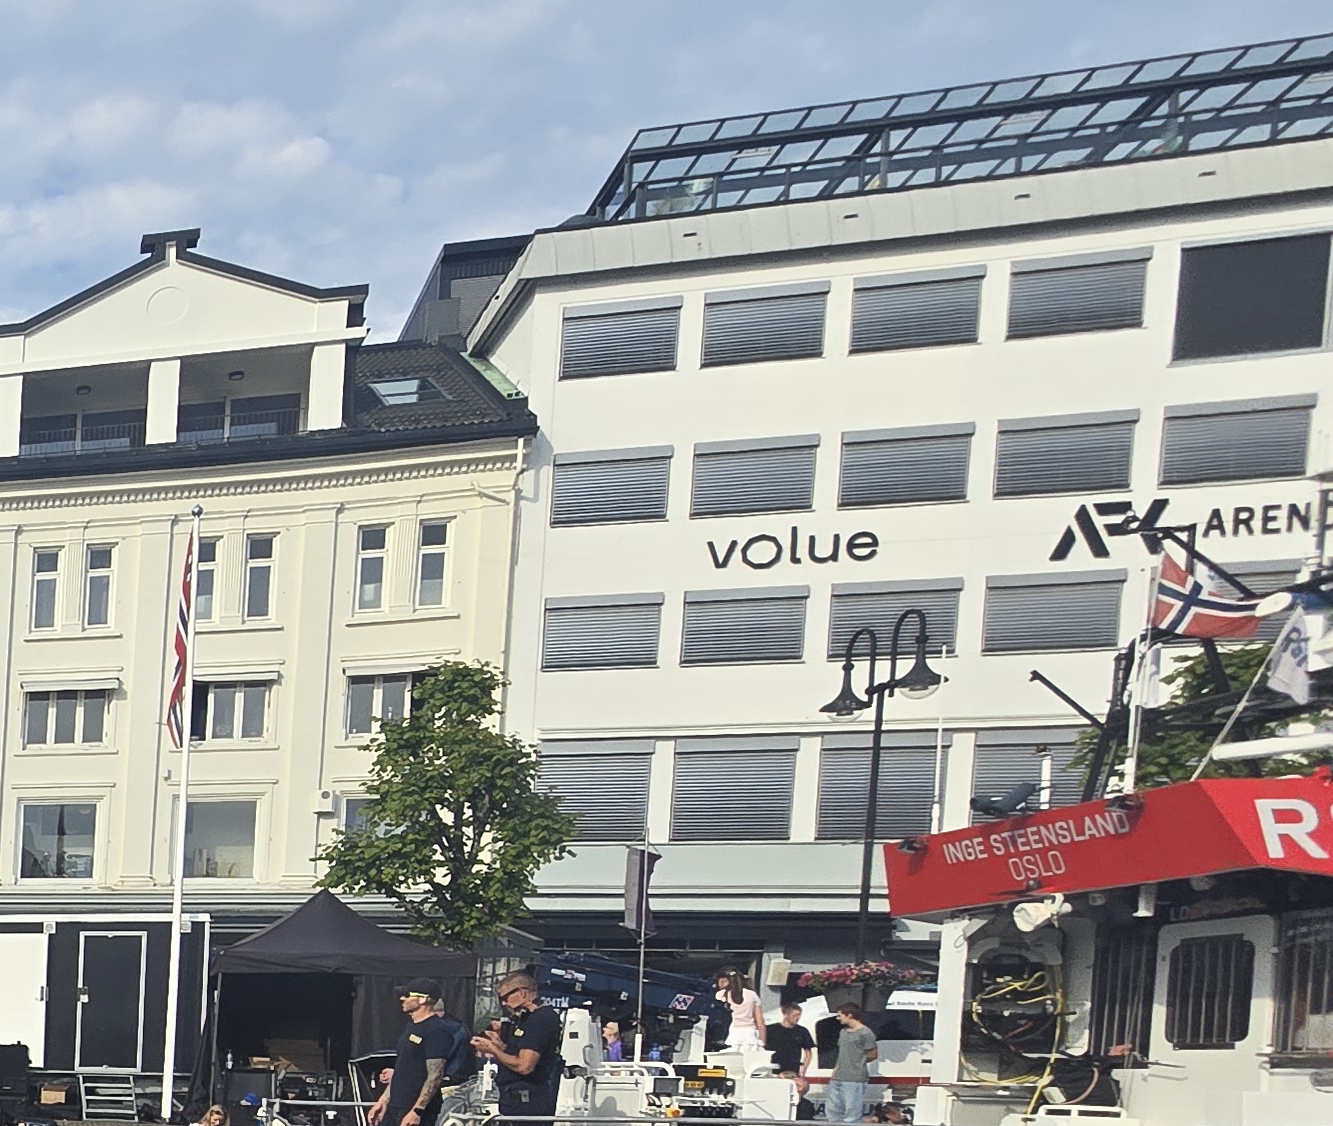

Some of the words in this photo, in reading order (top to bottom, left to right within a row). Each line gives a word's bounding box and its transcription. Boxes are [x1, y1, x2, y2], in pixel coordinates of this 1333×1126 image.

[706, 525, 880, 570] volue
[942, 837, 989, 865] INGE
[989, 811, 1131, 857] STEENSLAND
[1254, 798, 1333, 860] R
[1007, 850, 1067, 882] OSLO
